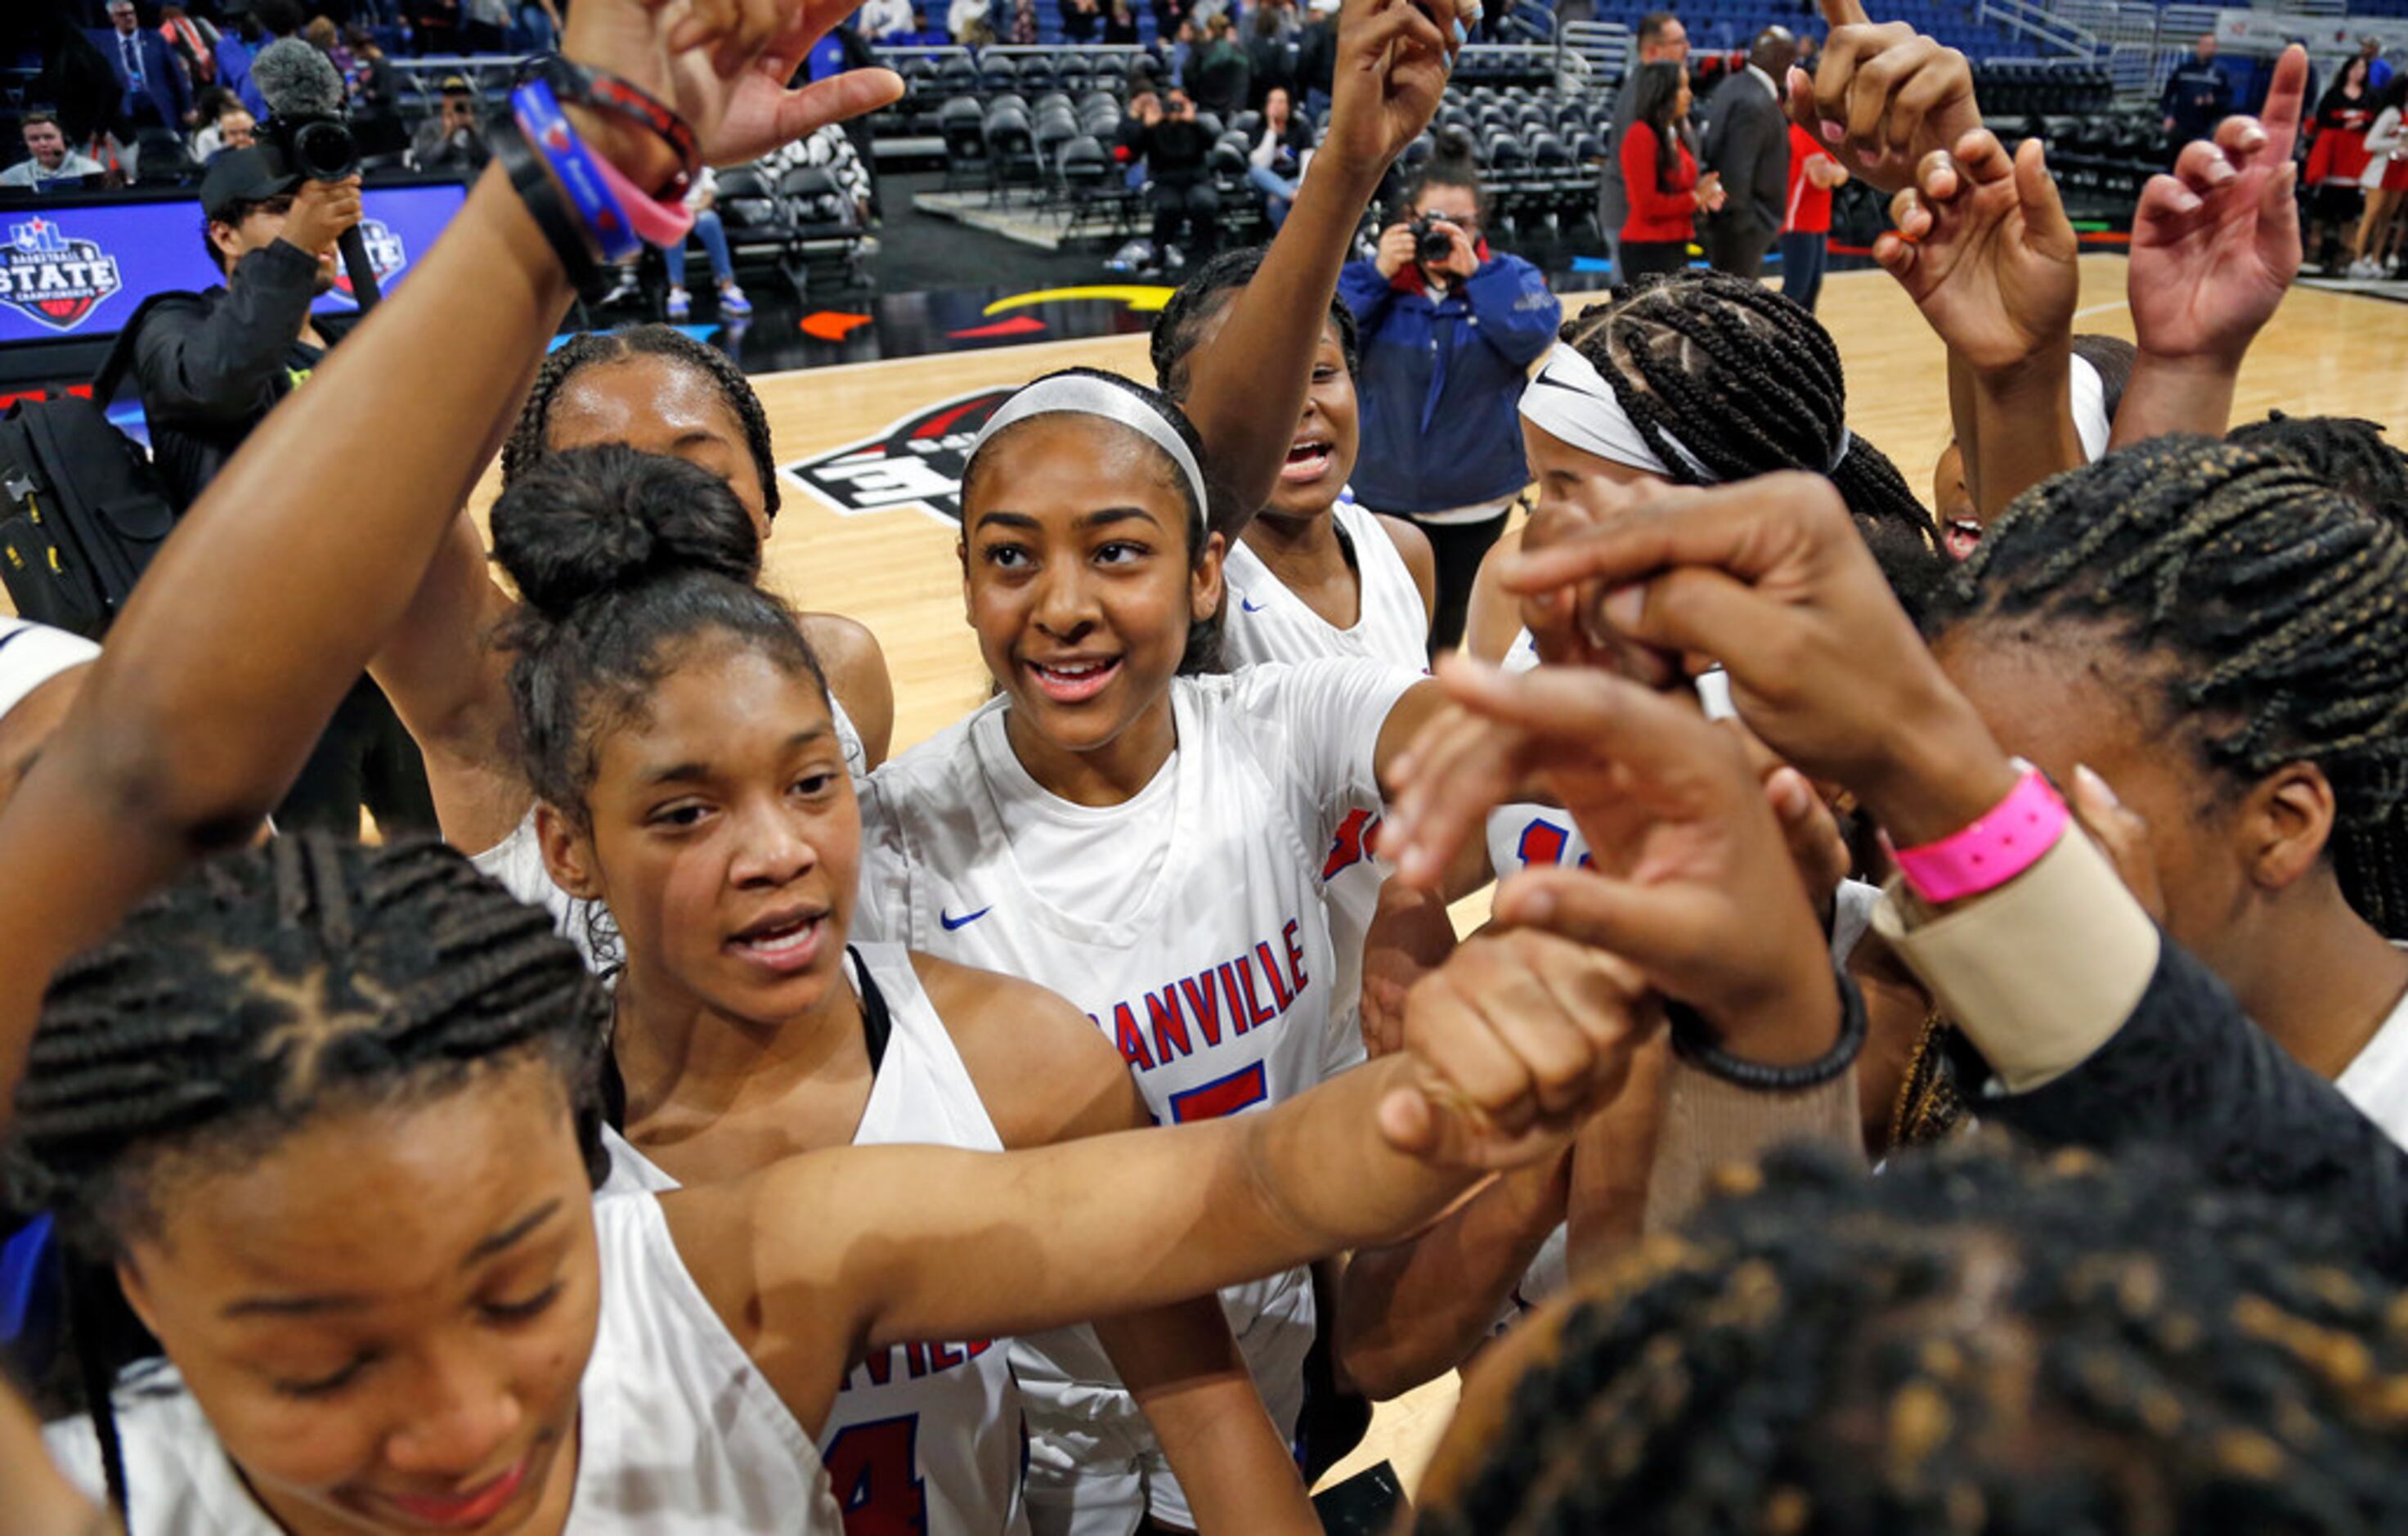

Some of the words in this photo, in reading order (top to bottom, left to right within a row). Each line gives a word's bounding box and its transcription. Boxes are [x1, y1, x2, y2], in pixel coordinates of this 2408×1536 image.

[9, 221, 69, 253] UIL
[0, 260, 114, 292] STATE
[1087, 918, 1310, 1072] ANVILLE
